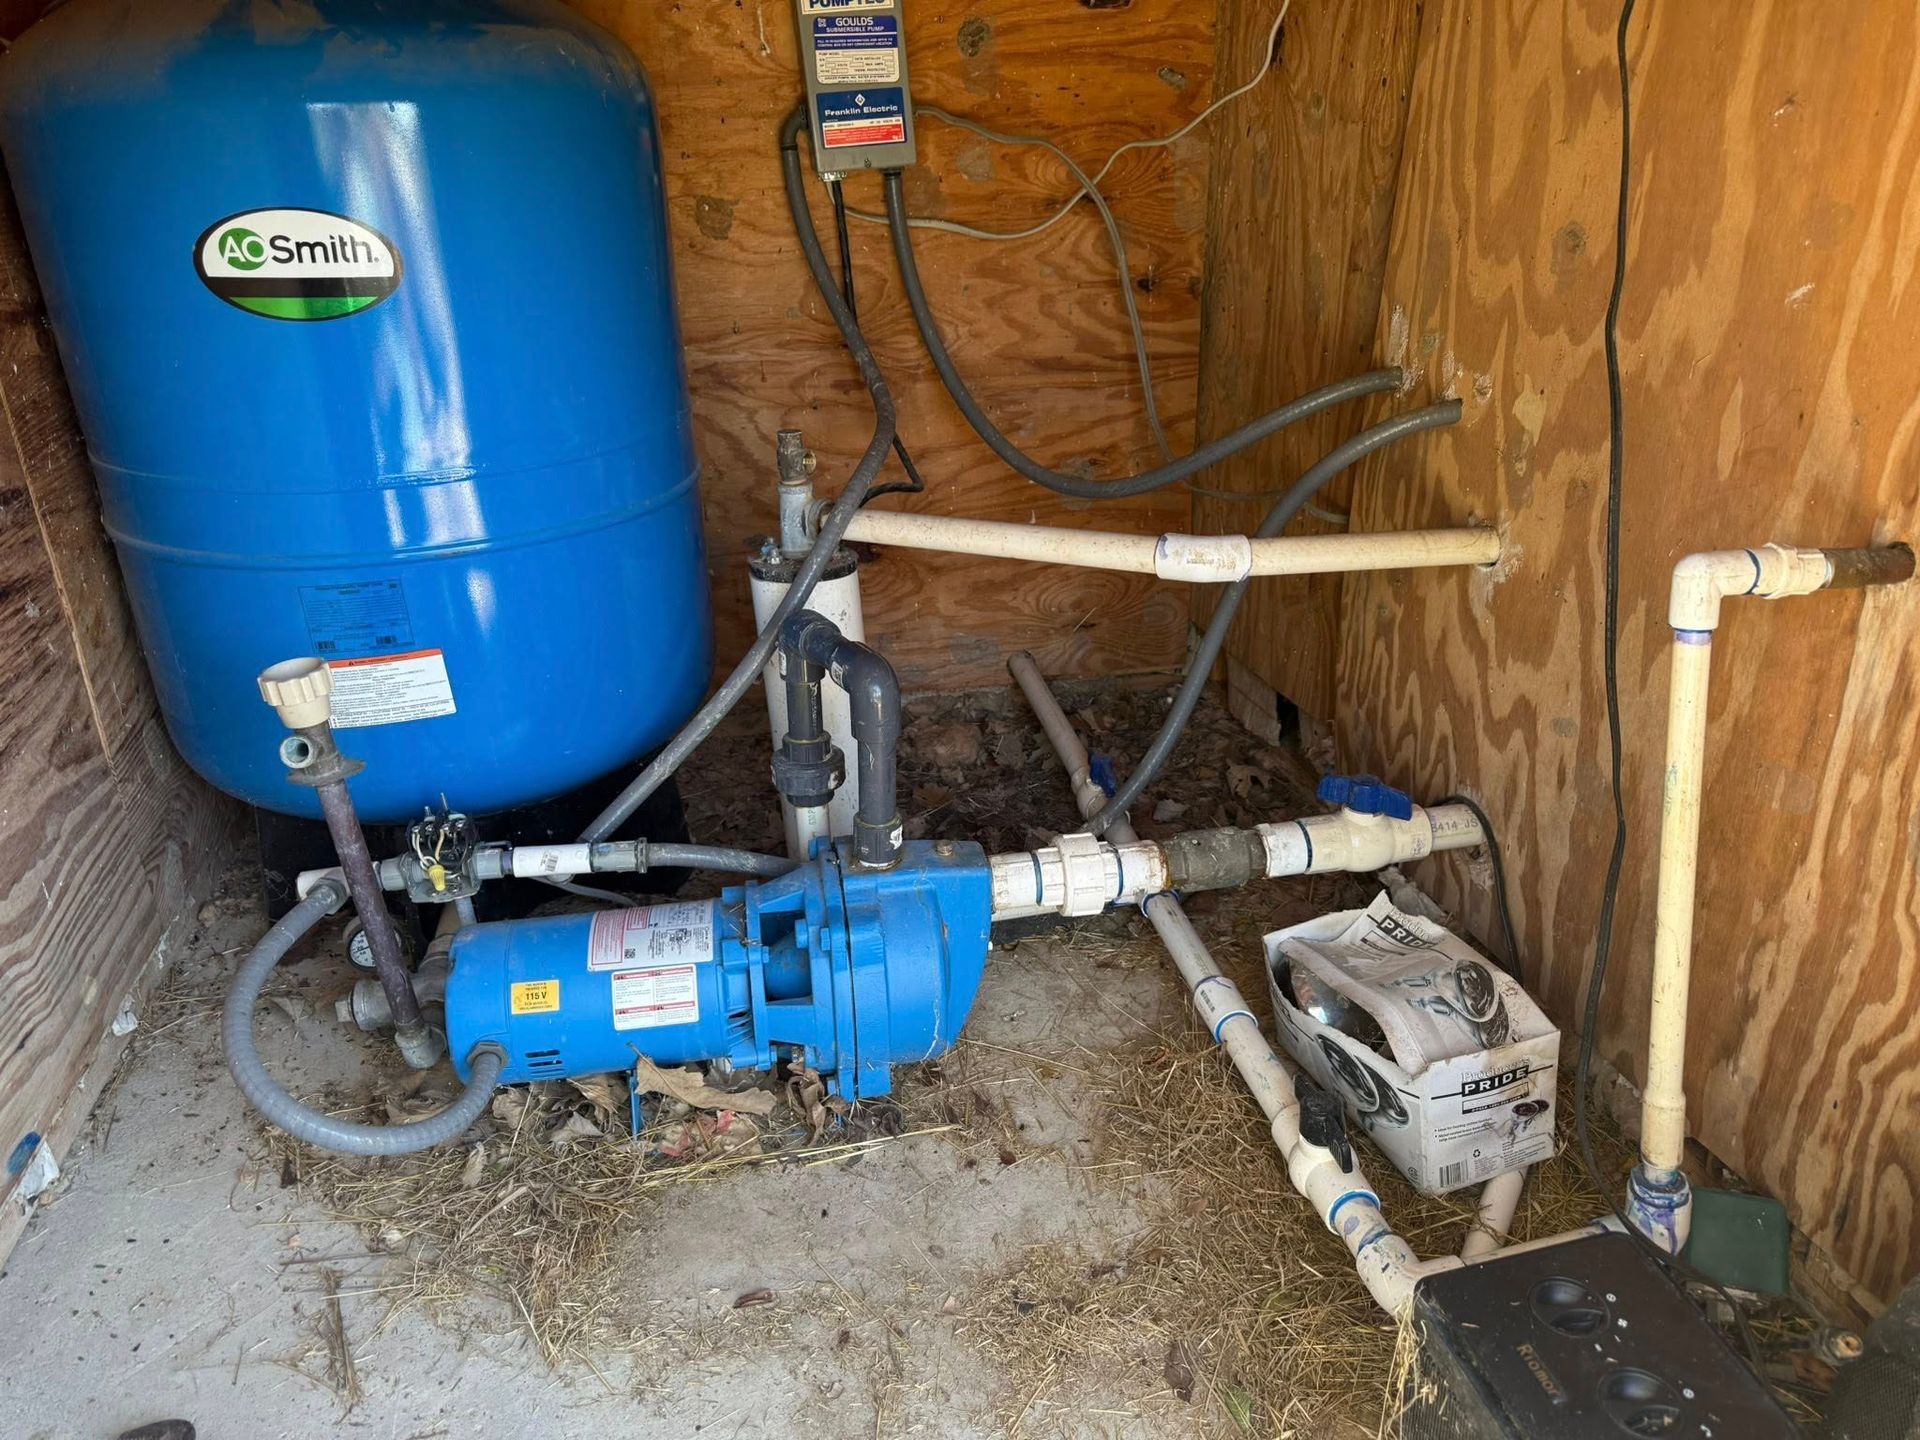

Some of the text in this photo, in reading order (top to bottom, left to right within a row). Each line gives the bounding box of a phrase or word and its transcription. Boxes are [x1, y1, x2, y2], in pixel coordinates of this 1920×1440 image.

[835, 16, 874, 27] GOULDS
[824, 104, 898, 117] Franklin Electric
[269, 234, 373, 264] Smith
[525, 991, 547, 1001] 115 V
[1464, 1067, 1528, 1095] PRIDE
